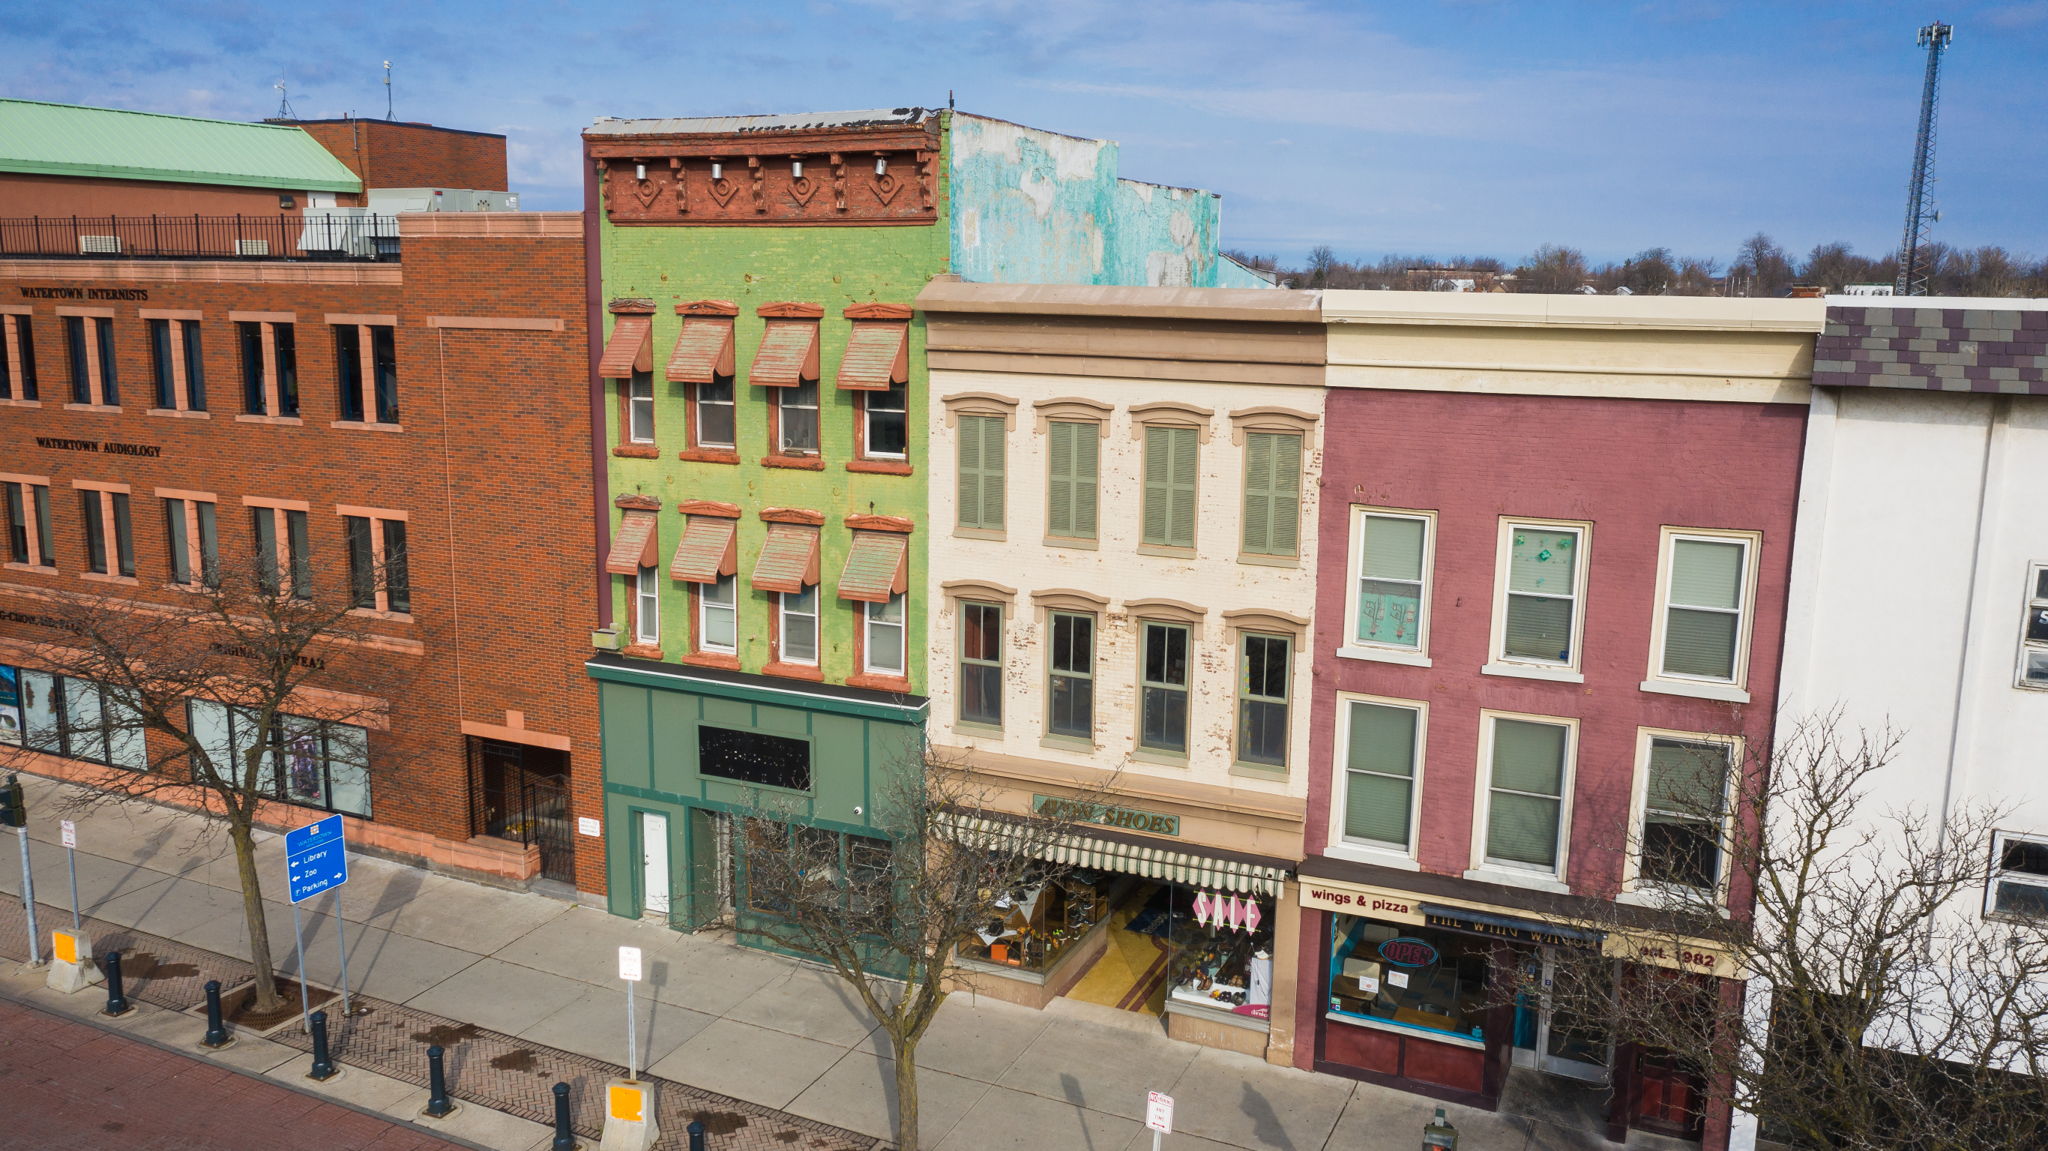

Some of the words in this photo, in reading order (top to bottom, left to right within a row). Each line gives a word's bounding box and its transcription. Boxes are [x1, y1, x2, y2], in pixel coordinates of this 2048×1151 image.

[21, 287, 83, 299] WATERTOWN
[88, 288, 148, 301] INTERNISTS
[36, 437, 98, 452] WATERTOWN
[104, 442, 161, 457] AUDIOLOGY
[1104, 808, 1176, 833] SHOES
[303, 850, 328, 864] Library
[305, 868, 317, 878] Zoo
[302, 879, 328, 894] Parking
[1198, 891, 1256, 932] SALE
[1311, 889, 1351, 905] wings
[1356, 895, 1366, 906] &
[1372, 899, 1408, 914] pizza
[1384, 942, 1433, 964] OPEN
